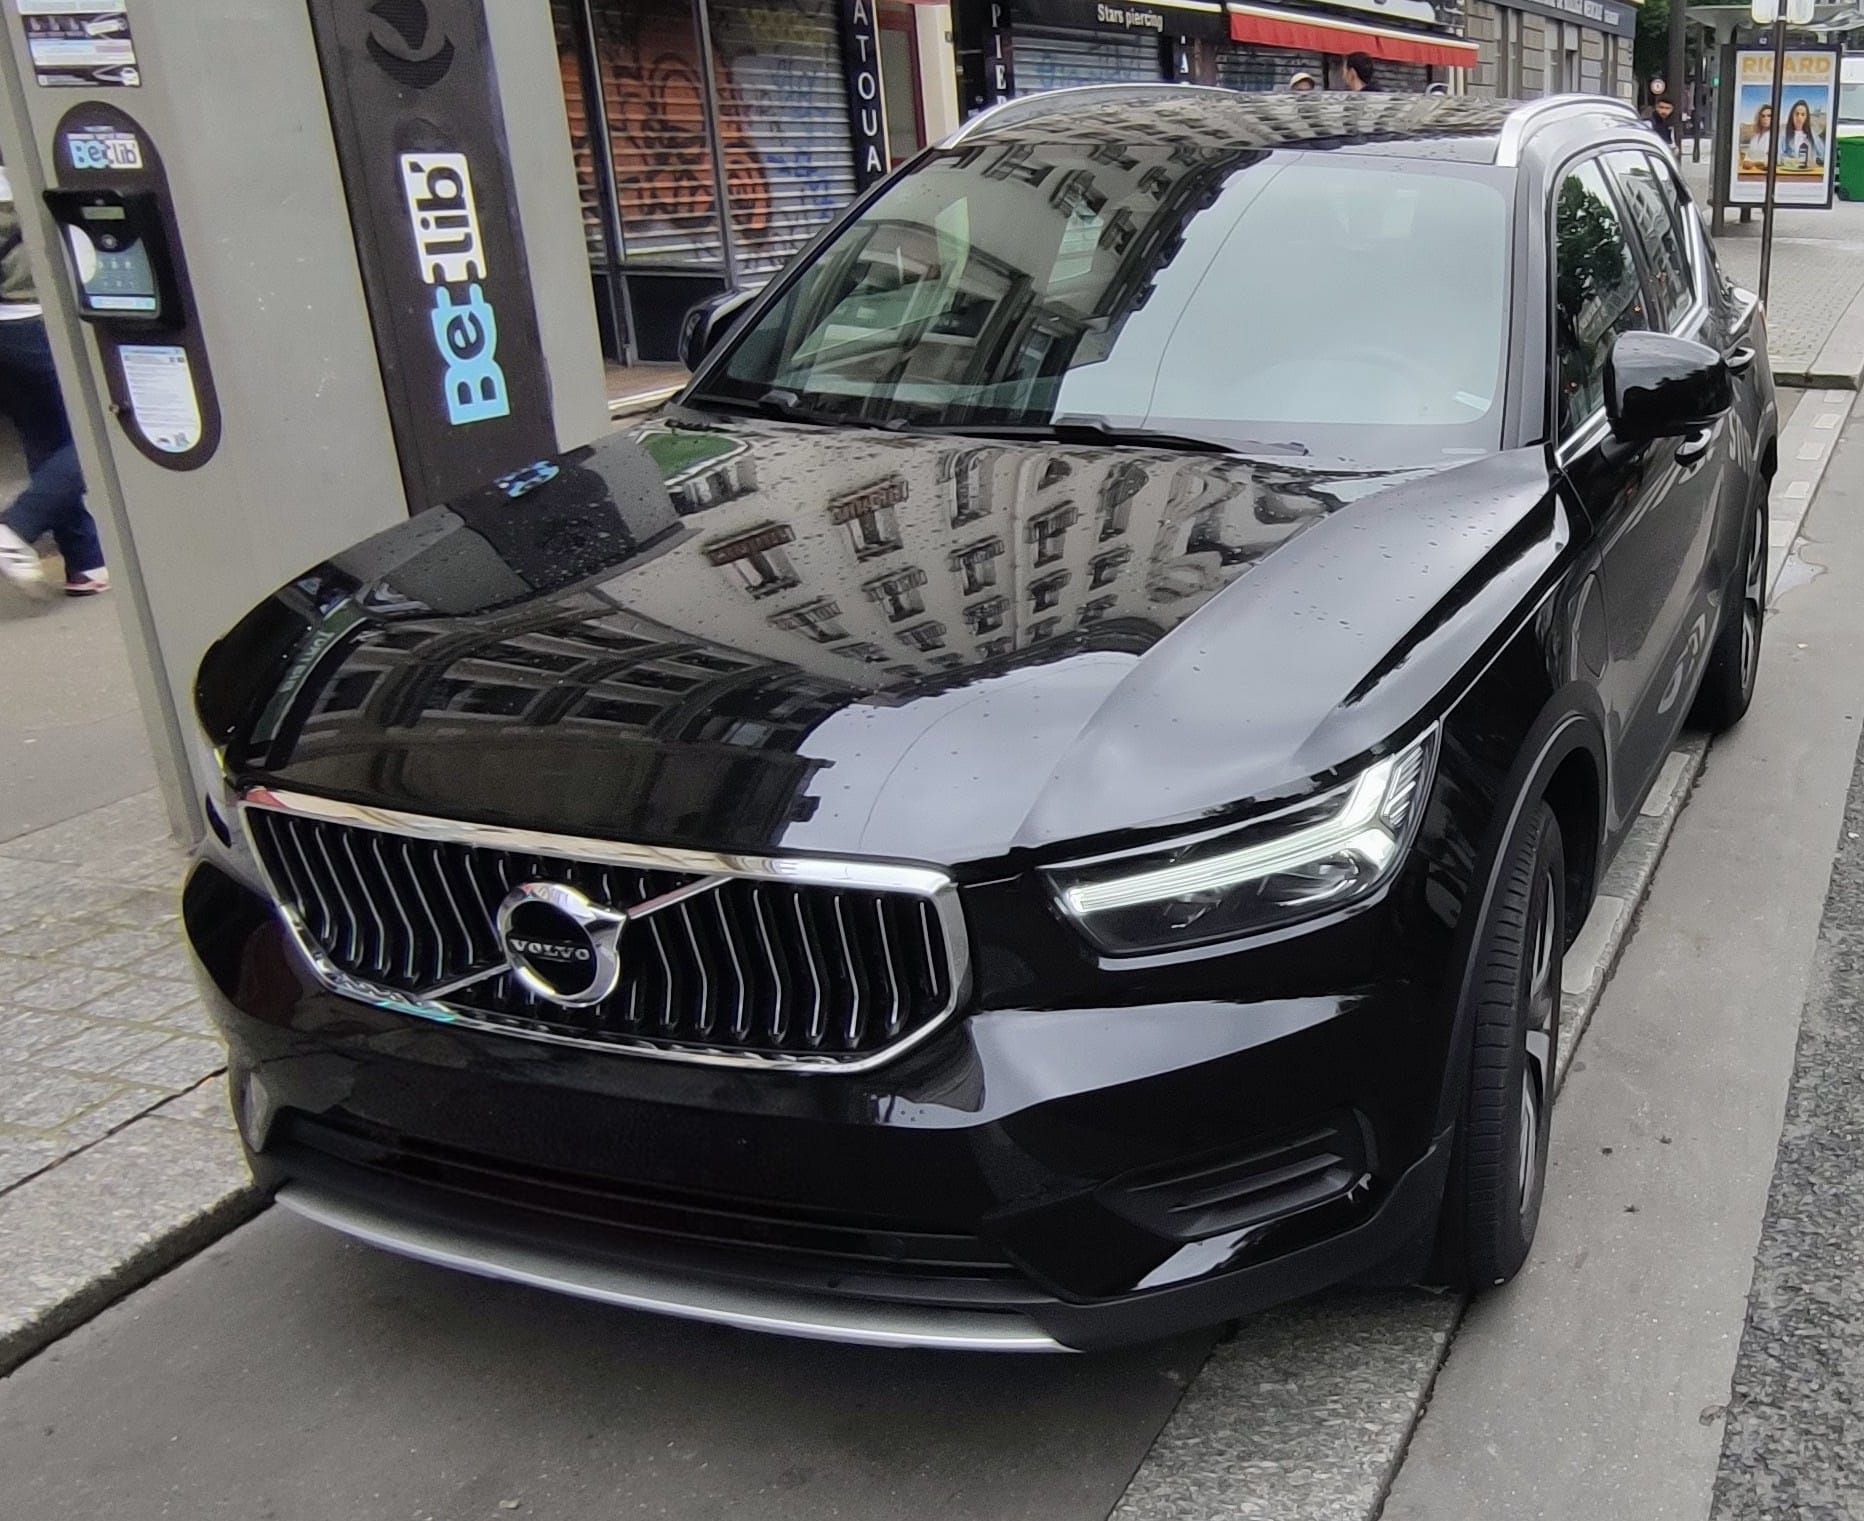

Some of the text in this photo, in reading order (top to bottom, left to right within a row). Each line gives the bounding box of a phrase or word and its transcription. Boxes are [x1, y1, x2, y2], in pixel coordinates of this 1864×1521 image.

[1097, 3, 1164, 33] Stars piercing
[510, 939, 590, 960] VOLVO
